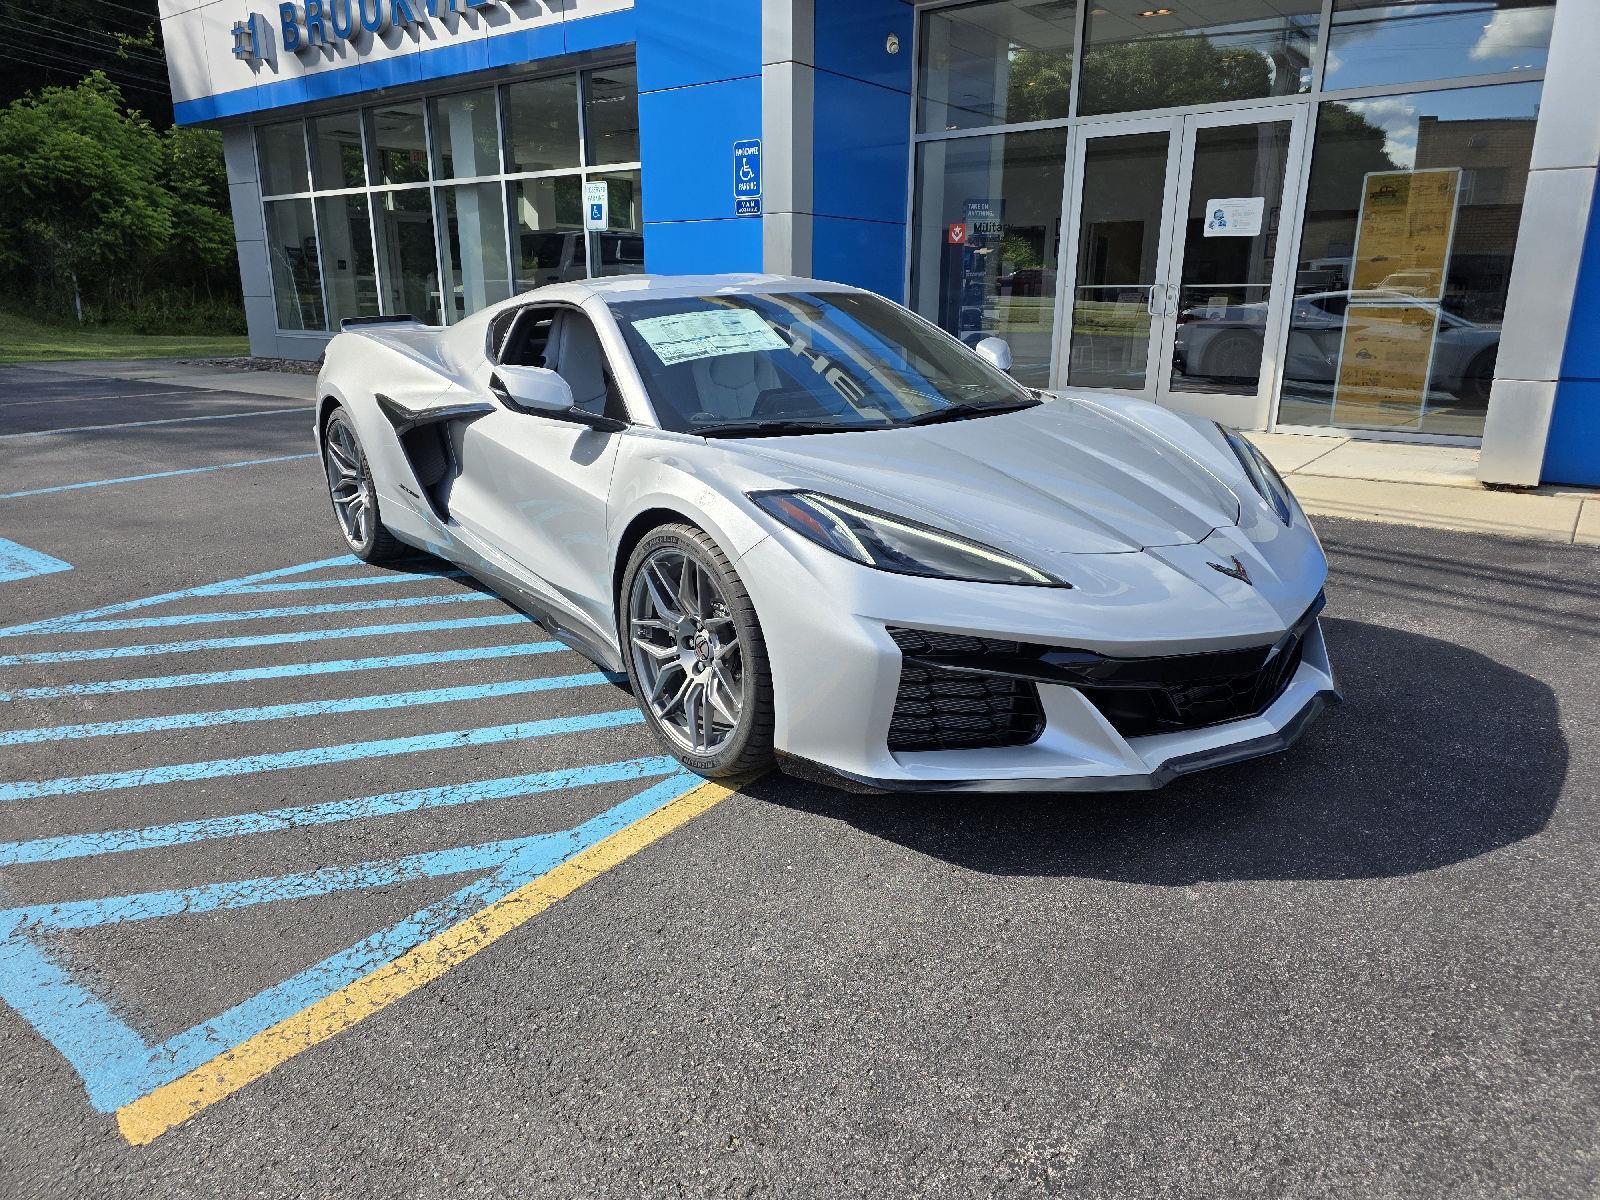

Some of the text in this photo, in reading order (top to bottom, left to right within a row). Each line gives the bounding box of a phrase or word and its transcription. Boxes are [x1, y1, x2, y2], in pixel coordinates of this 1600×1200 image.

[279, 0, 490, 51] BROOK
[973, 221, 1015, 234] Military
[643, 535, 679, 550] MICHELIN
[682, 756, 714, 769] MICHELIN
